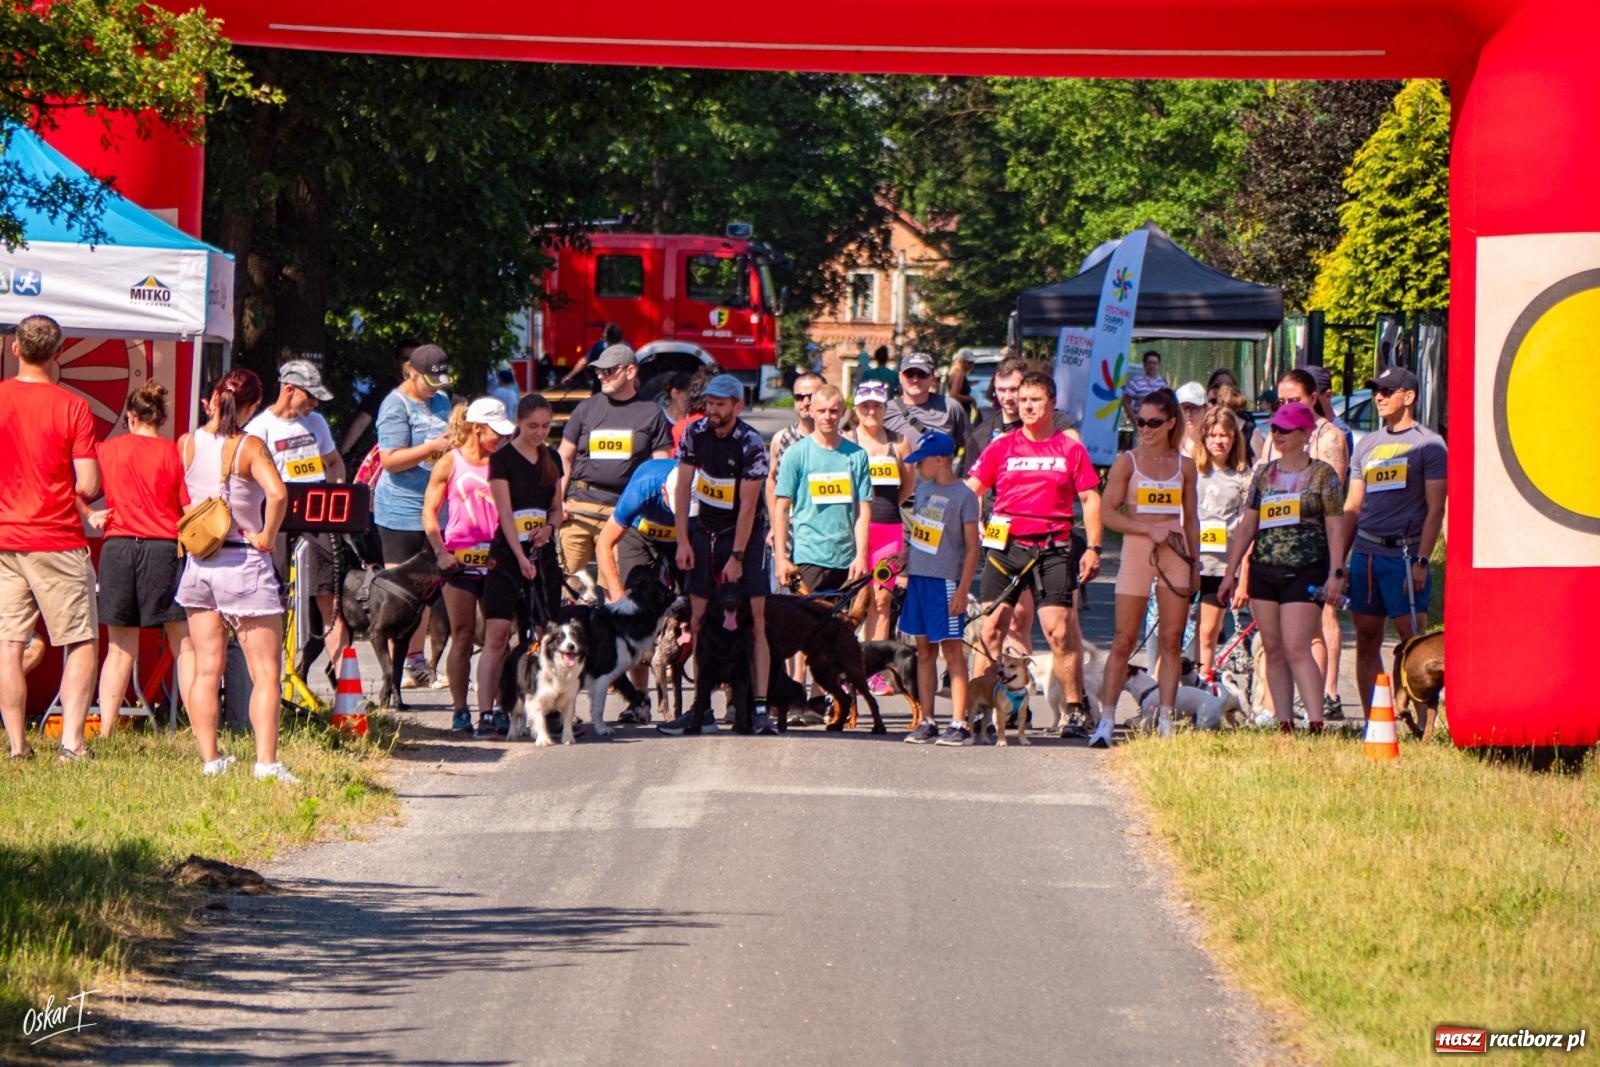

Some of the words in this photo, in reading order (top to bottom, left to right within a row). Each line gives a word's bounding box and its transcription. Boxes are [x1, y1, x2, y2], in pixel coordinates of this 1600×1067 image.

[129, 288, 171, 302] MITKO
[598, 441, 623, 450] 009
[294, 462, 315, 475] 006
[869, 467, 892, 476] 030
[1376, 470, 1398, 481] 017
[702, 484, 724, 499] 013
[818, 484, 842, 495] 001
[1148, 493, 1172, 504] 021
[1267, 505, 1291, 518] 020
[648, 528, 672, 539] 012
[913, 527, 930, 542] 031
[1202, 533, 1217, 542] 23
[464, 554, 488, 565] 029
